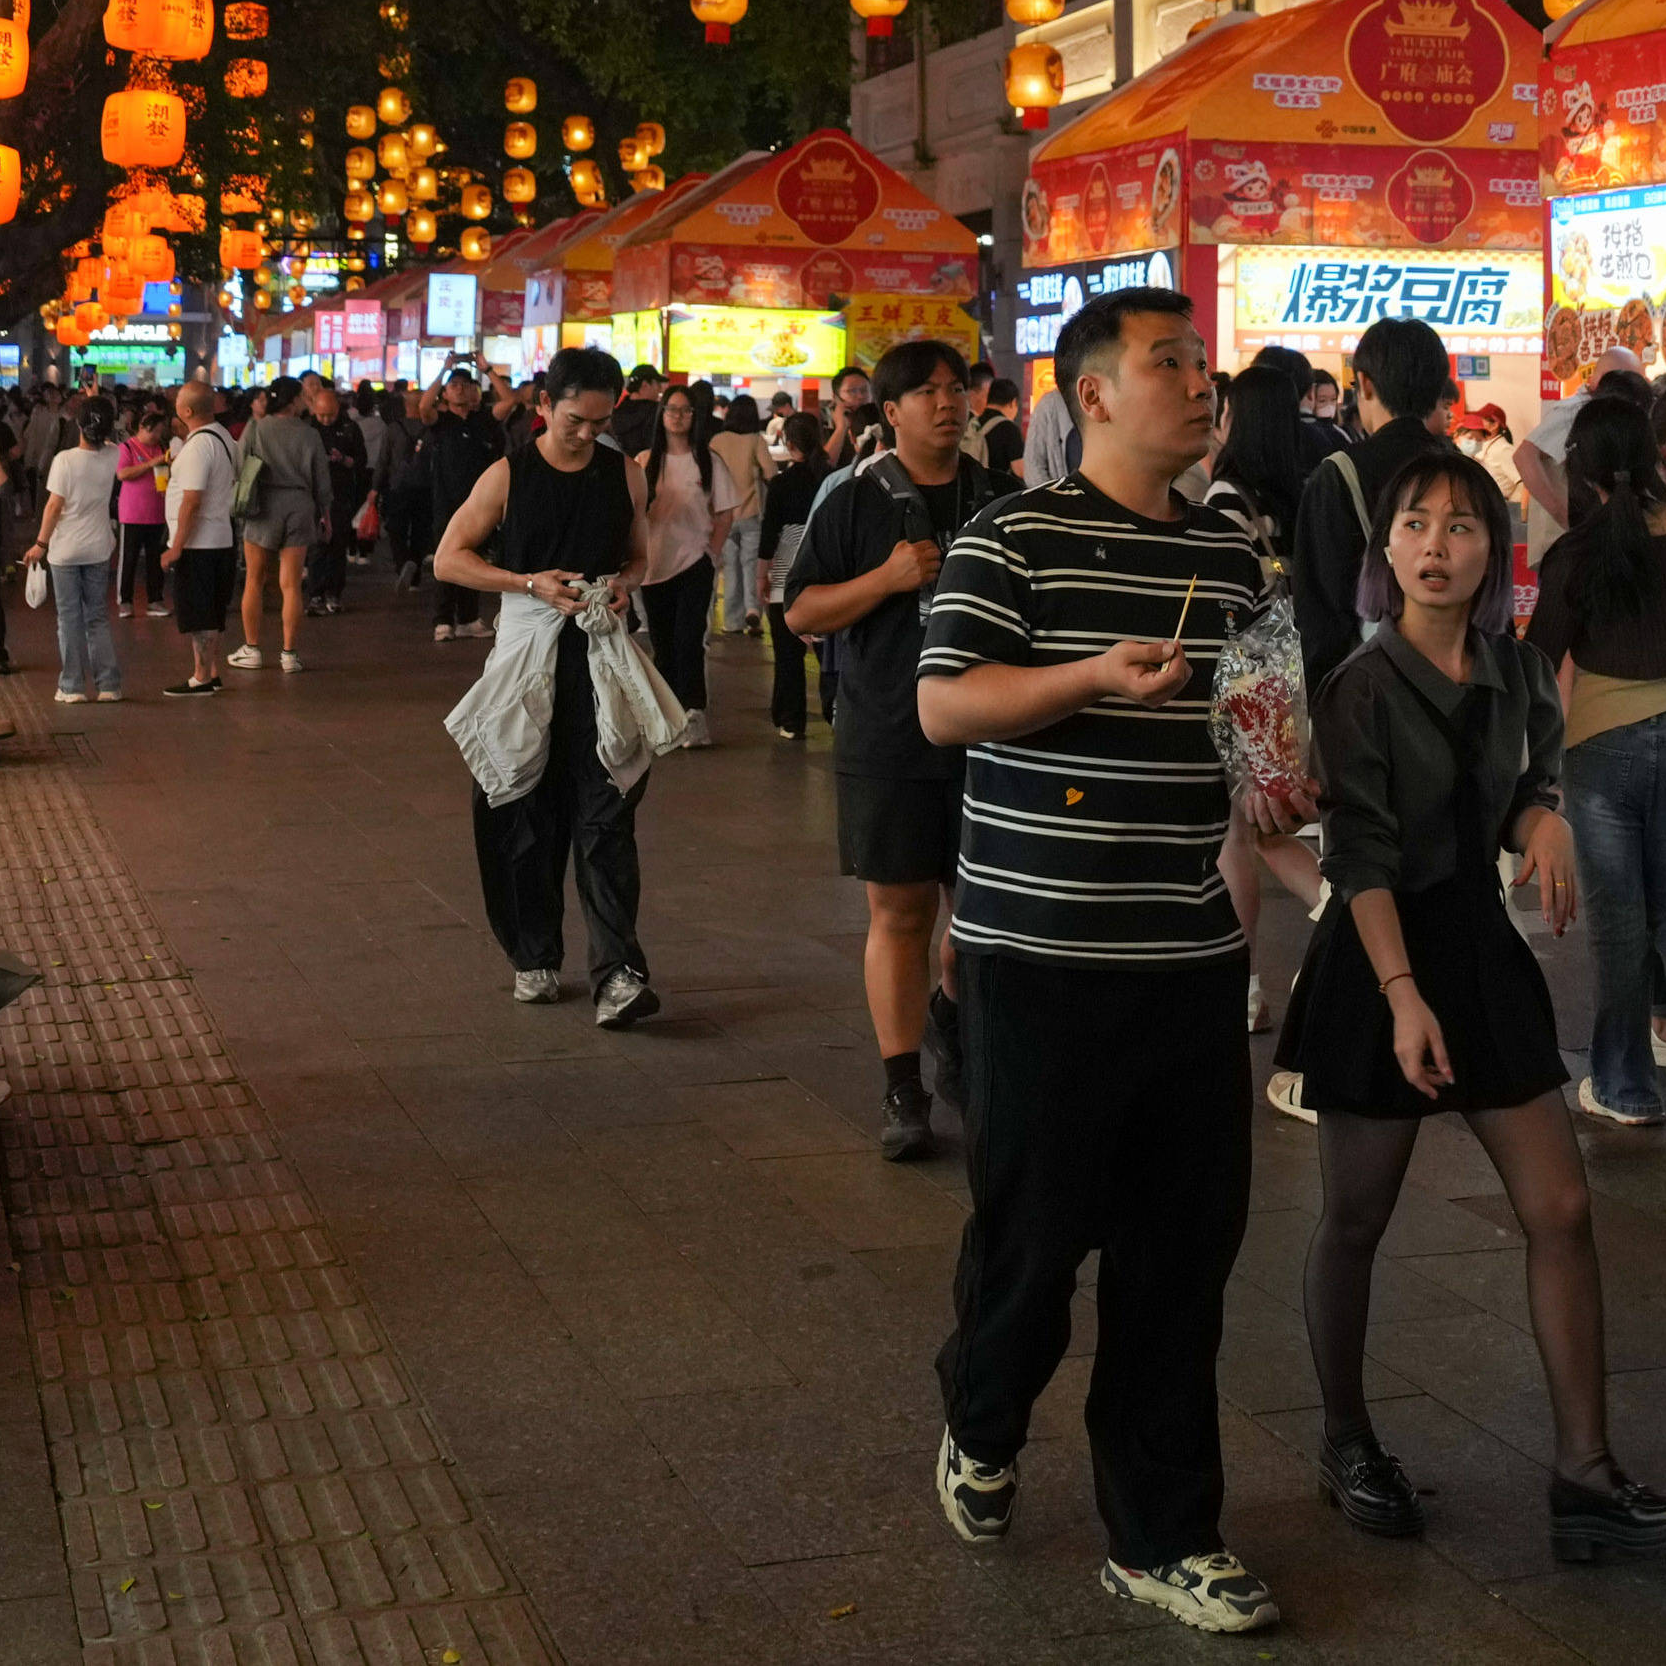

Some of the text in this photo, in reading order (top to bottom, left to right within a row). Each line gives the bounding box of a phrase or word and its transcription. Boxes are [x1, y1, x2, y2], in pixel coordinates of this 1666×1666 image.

[1602, 219, 1644, 249] 拇指
[1600, 251, 1652, 280] 生煎包
[1282, 263, 1509, 326] 爆浆豆腐
